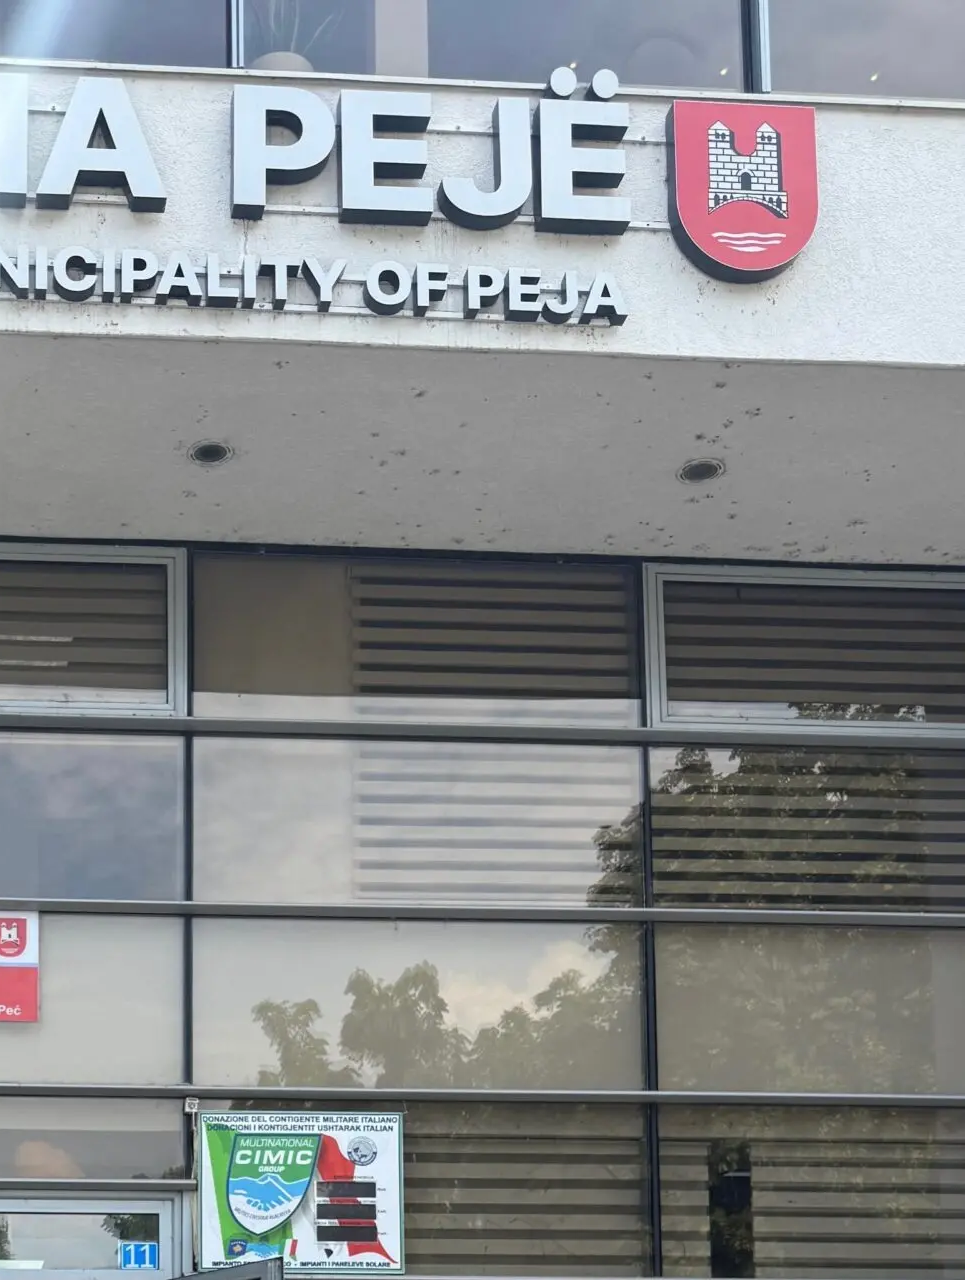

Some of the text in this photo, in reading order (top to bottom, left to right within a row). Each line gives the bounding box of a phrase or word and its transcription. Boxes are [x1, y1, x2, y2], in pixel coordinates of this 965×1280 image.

[232, 66, 630, 232] PEJË
[363, 260, 450, 316] OF
[463, 265, 629, 326] PEJA
[202, 1115, 249, 1123] DONAZIONE
[251, 1115, 266, 1123] DEL
[361, 1116, 398, 1124] ITALIANO
[240, 1138, 314, 1148] MULTINATIONAL
[235, 1150, 313, 1165] CIMIC
[125, 1244, 154, 1268] 11
